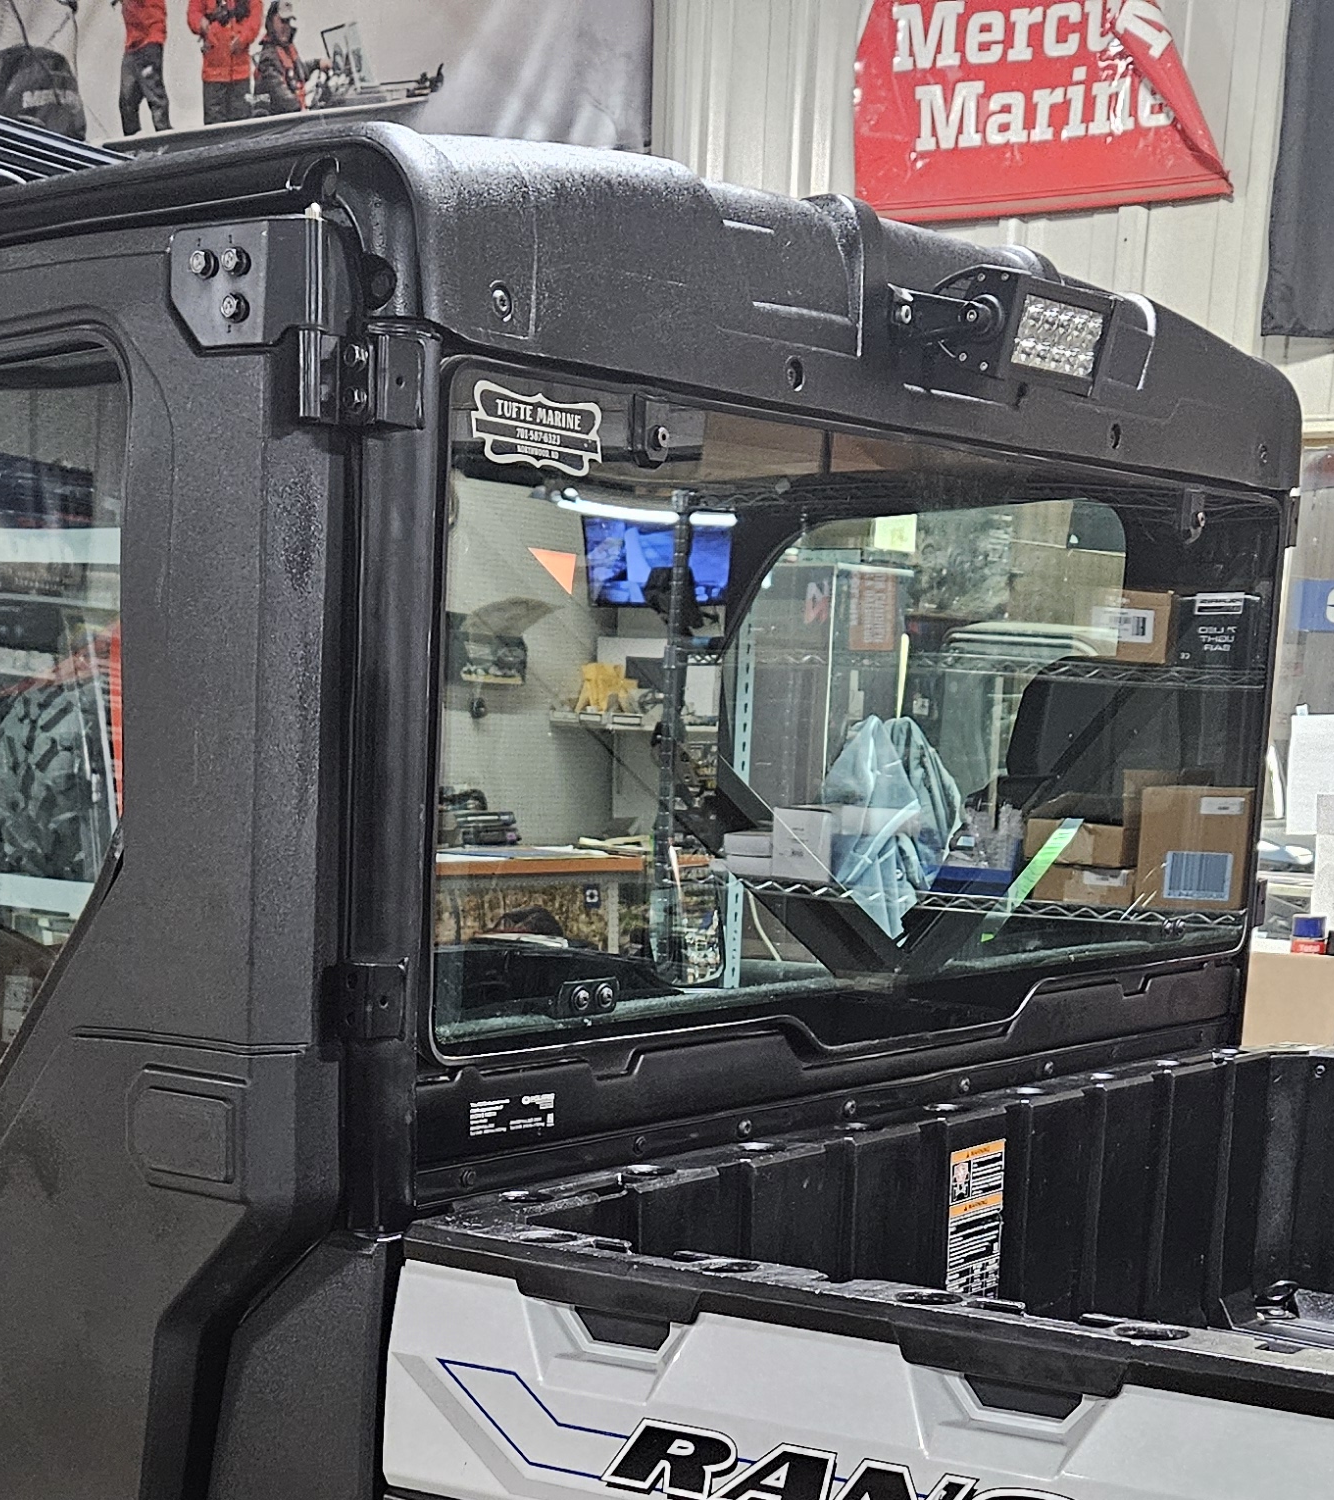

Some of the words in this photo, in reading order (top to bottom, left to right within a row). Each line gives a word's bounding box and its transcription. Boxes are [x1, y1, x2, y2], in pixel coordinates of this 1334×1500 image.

[892, 0, 1120, 73] Mercu
[914, 66, 1175, 153] Marine
[495, 398, 533, 422] TUFTE
[536, 407, 582, 431] MARINE
